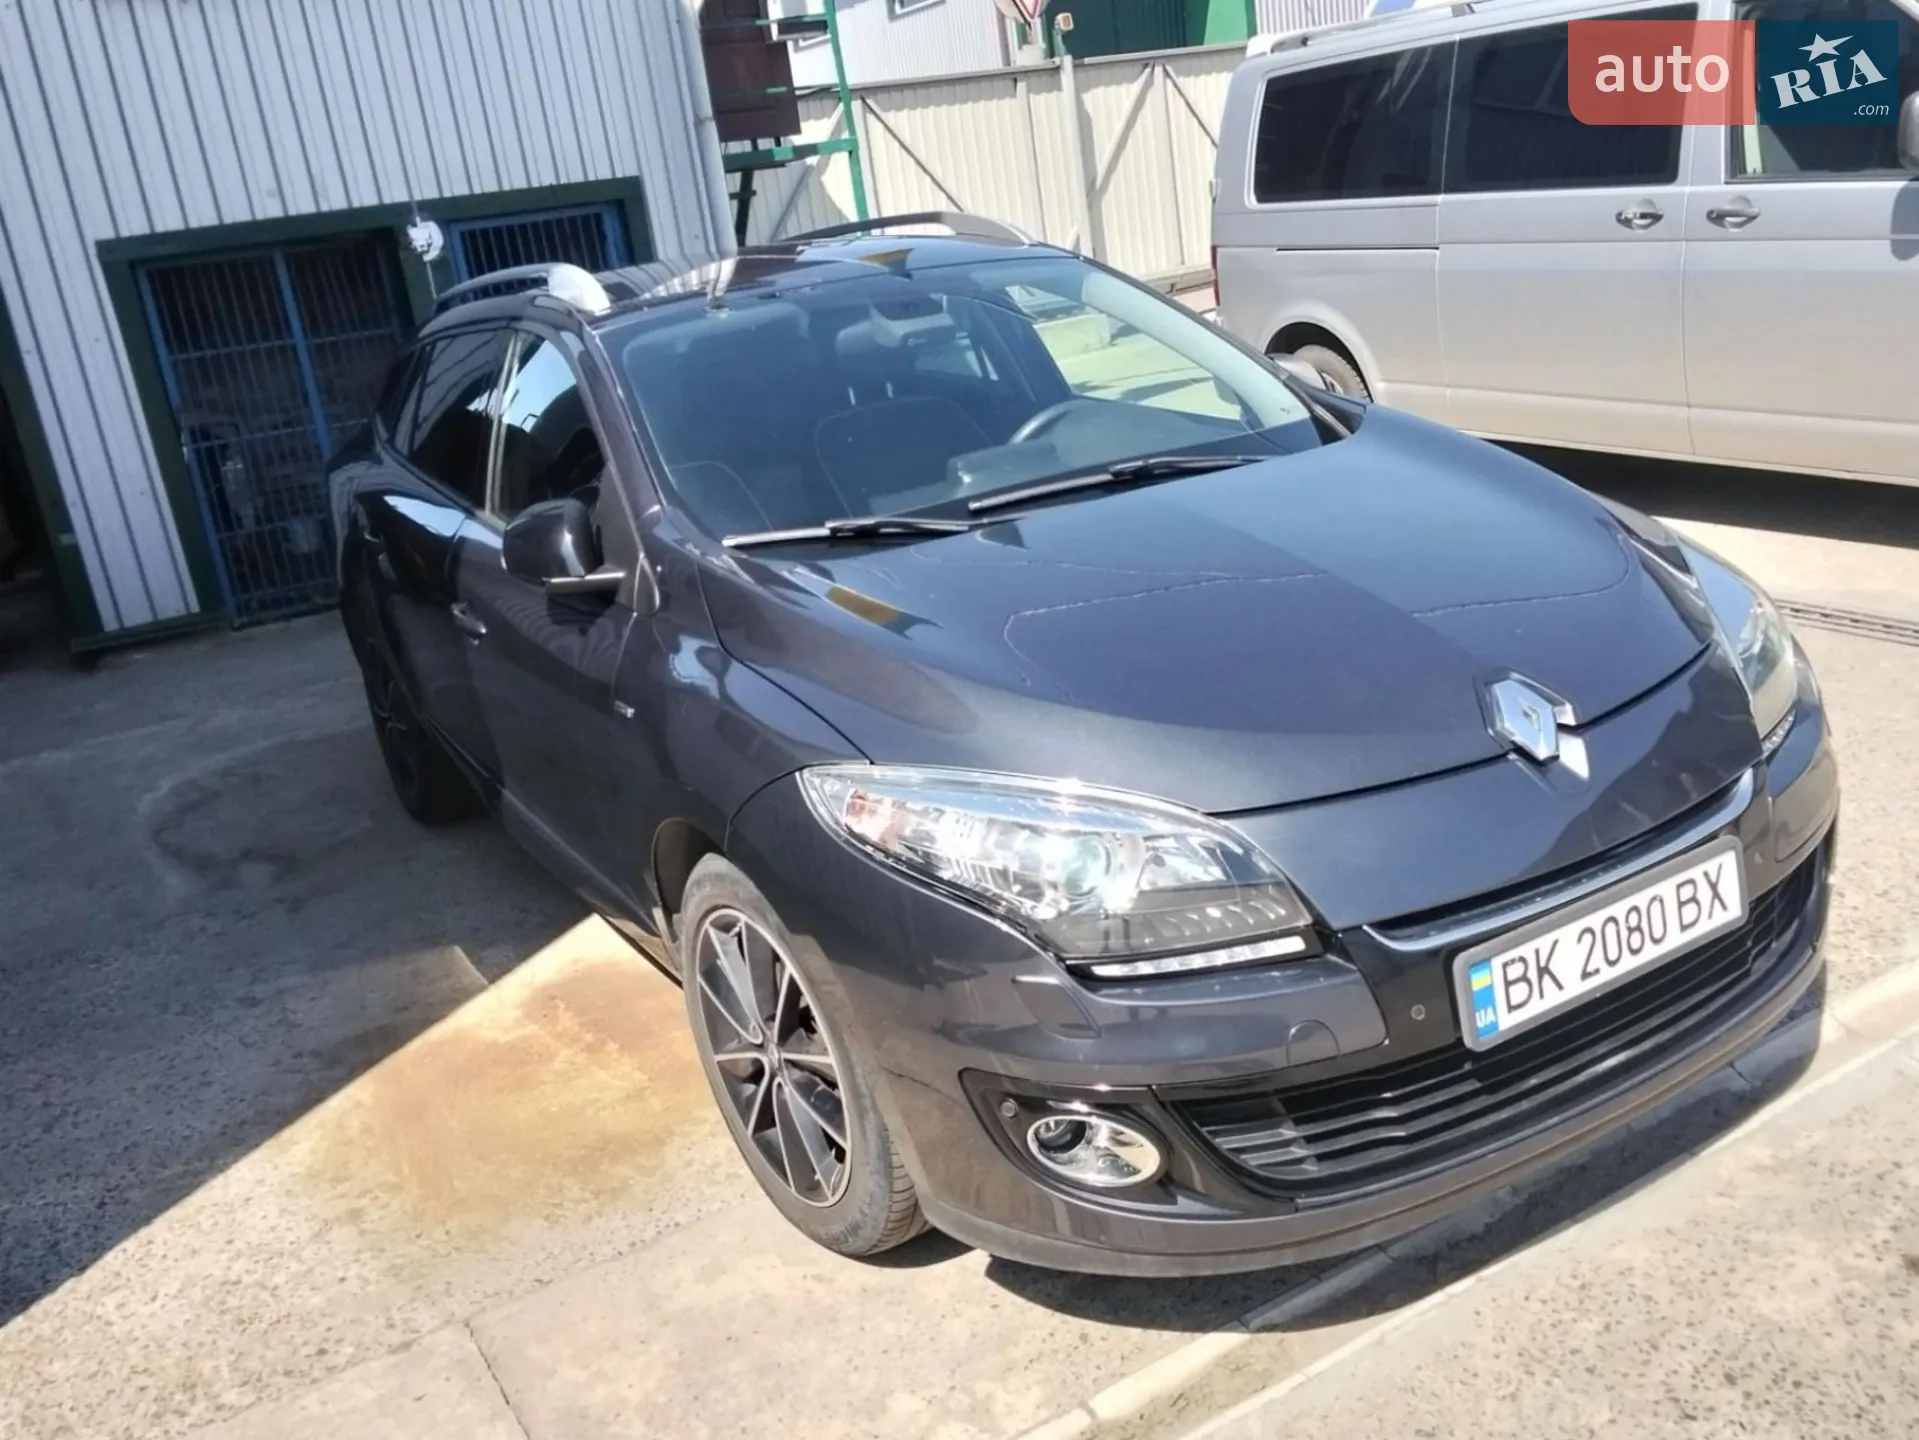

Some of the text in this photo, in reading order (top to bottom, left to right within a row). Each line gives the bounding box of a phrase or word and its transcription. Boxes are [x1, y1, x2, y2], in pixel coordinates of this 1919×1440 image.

[1501, 862, 1729, 1014] BK 2080 BX
[1475, 1009, 1497, 1028] UA
